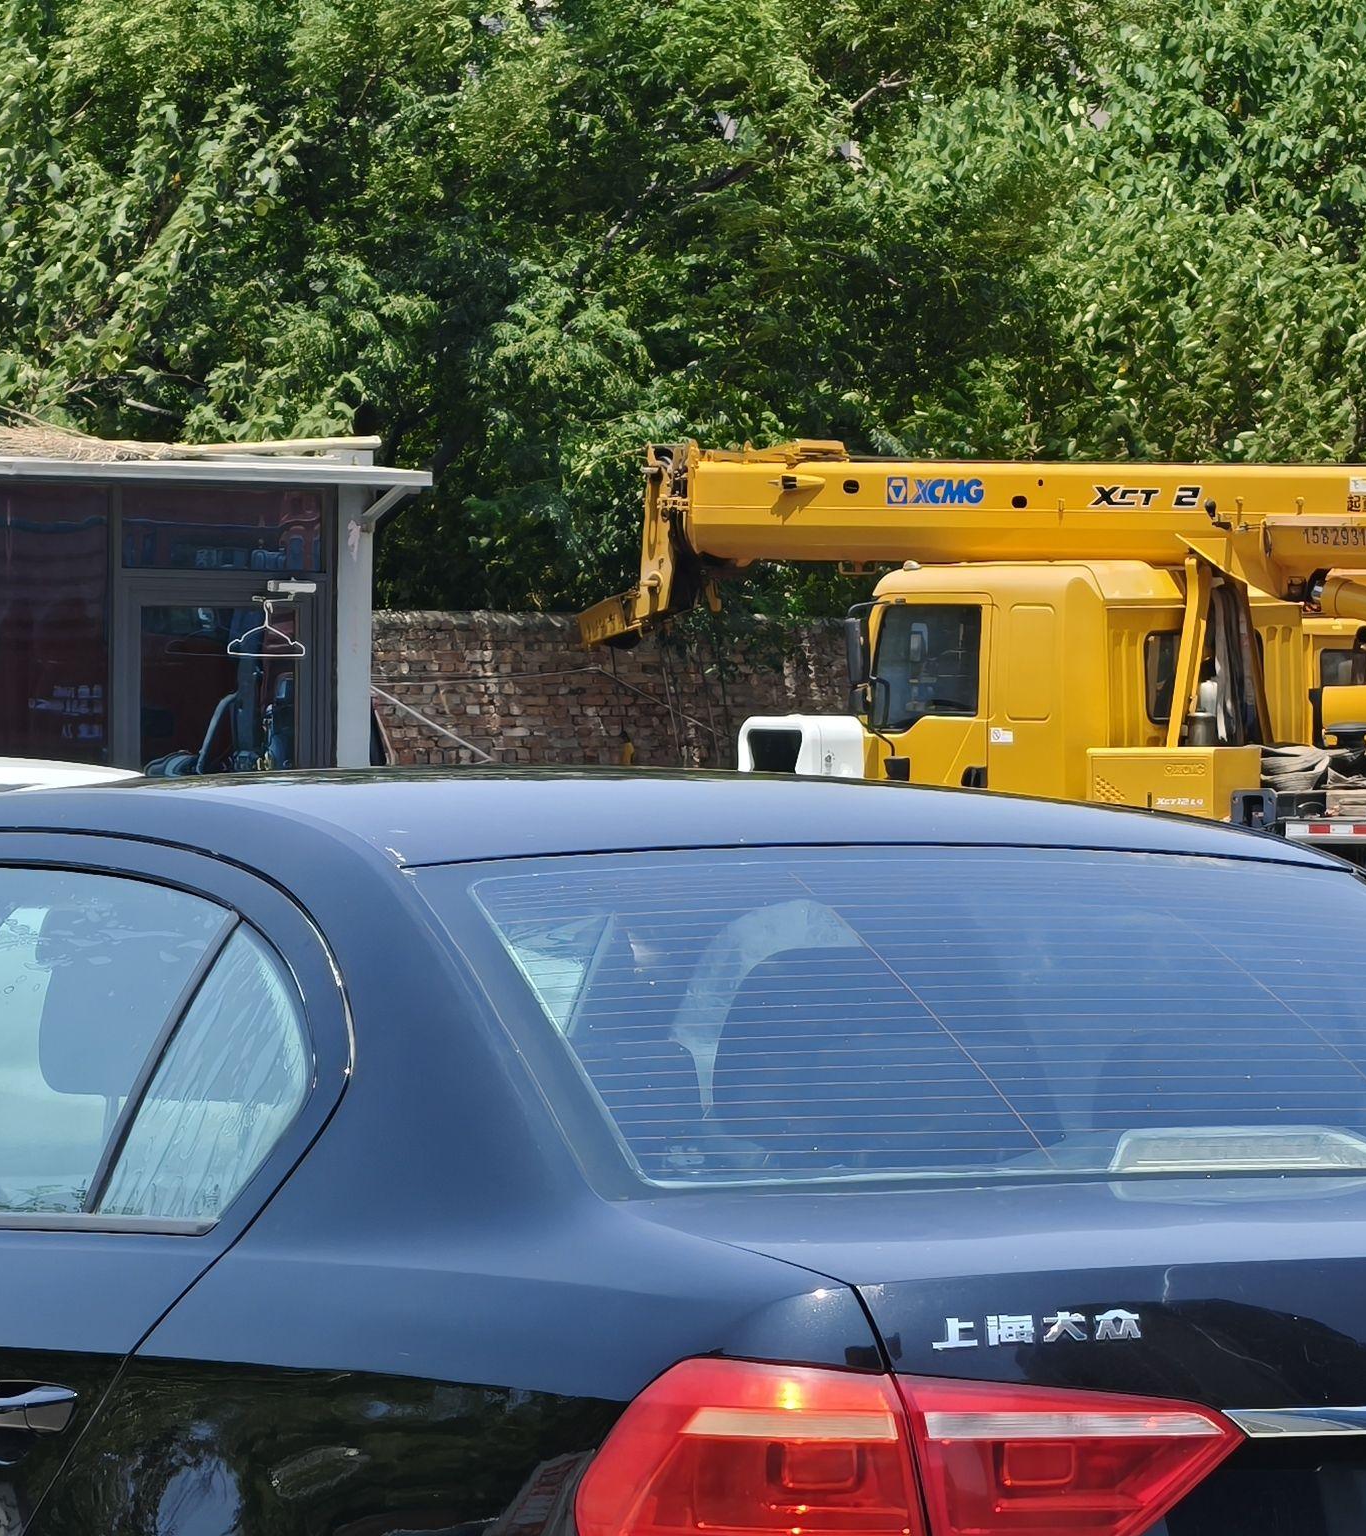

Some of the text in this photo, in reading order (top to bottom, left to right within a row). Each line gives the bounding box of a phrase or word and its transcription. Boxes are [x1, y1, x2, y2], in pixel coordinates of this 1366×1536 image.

[910, 478, 984, 504] XCMG
[932, 1308, 1142, 1350] 上海大众
